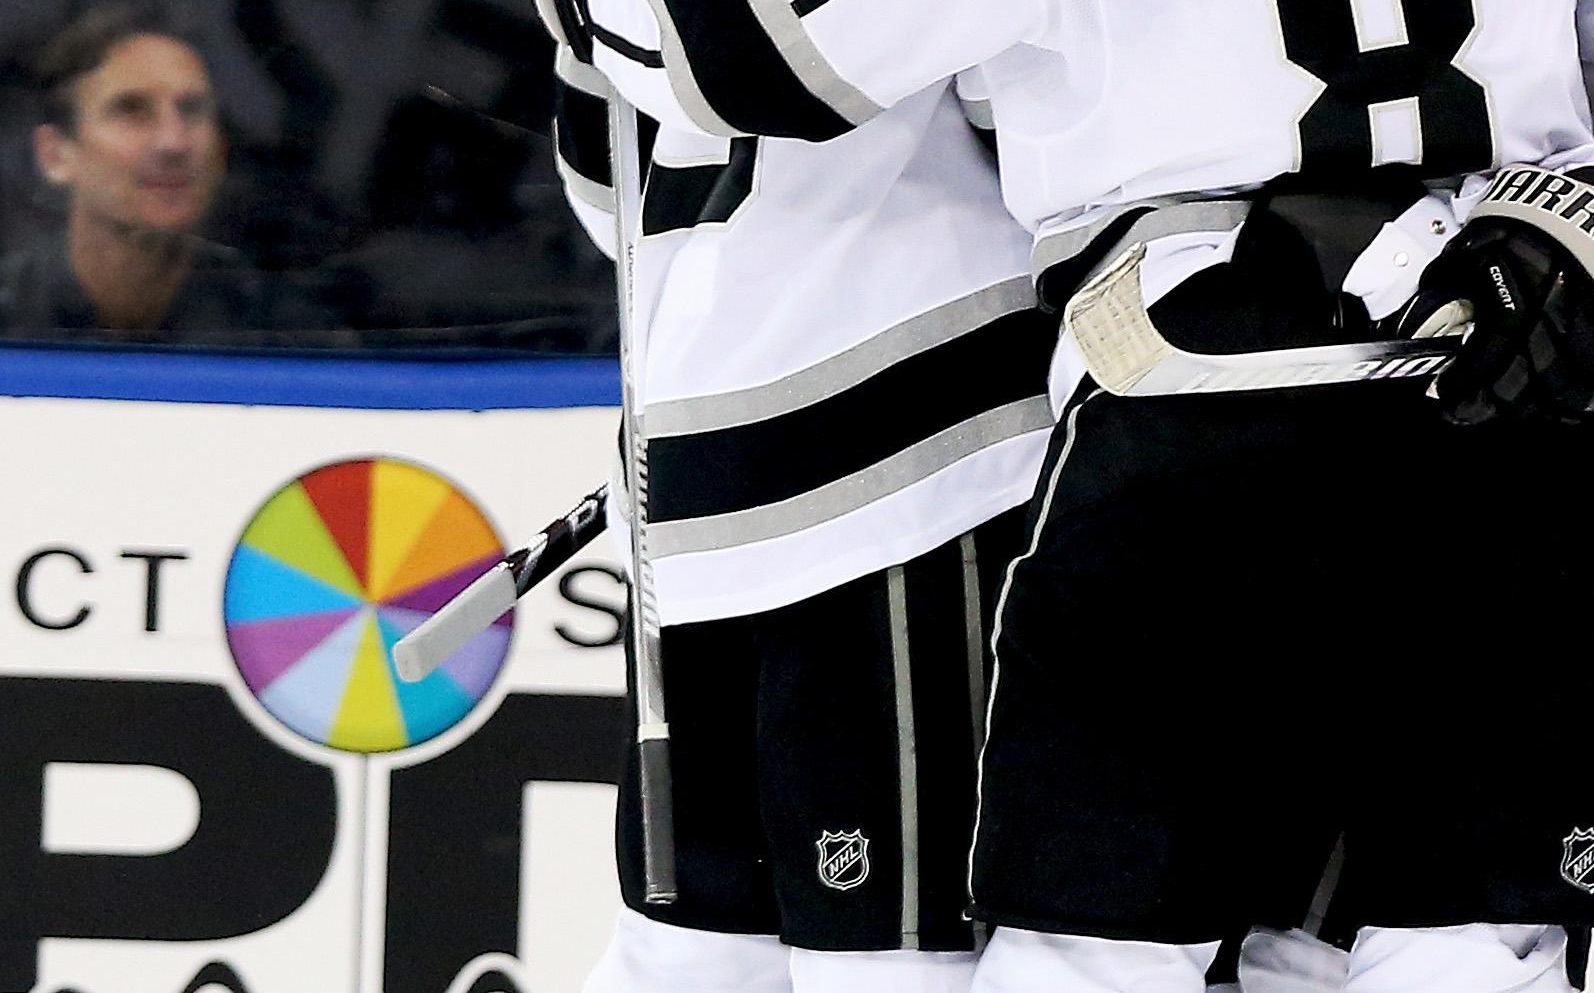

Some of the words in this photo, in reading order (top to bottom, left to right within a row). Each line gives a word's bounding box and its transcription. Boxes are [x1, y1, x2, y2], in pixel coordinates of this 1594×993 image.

[1489, 265, 1516, 311] COVERT
[15, 548, 189, 632] CT
[828, 845, 859, 878] NHL
